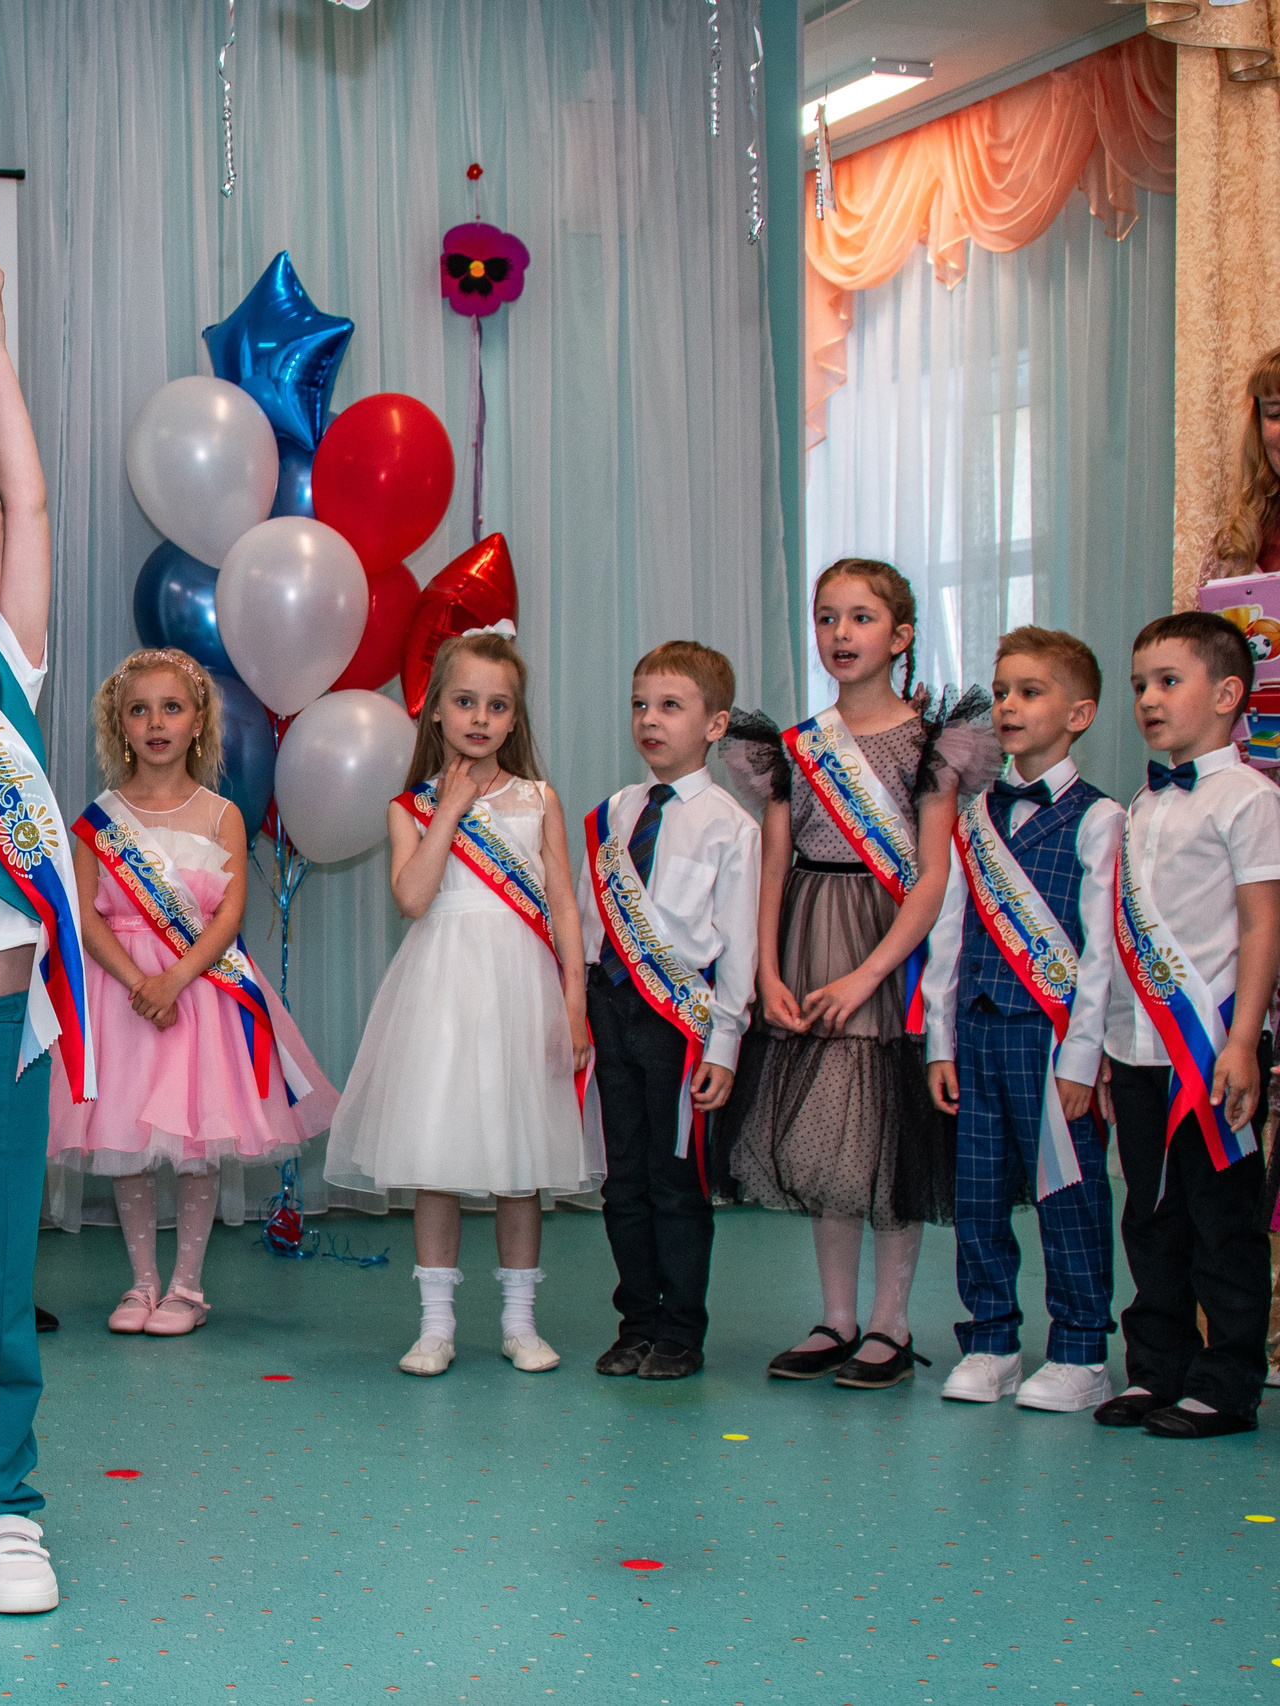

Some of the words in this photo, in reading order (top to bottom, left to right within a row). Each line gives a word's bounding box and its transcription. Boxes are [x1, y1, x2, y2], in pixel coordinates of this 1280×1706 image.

[812, 766, 867, 839] ДЕТСКОГО
[862, 837, 898, 879] САДА
[825, 752, 915, 874] Выпускник
[115, 861, 170, 929] ДЕТСКОГО
[166, 925, 190, 954] САД
[125, 850, 205, 940] Выпускни
[453, 829, 507, 883] ЕТСКОГО
[504, 882, 540, 919] САДА
[970, 827, 1055, 954] Выпускник
[601, 888, 642, 963] ДЕТСКОГО
[636, 962, 671, 1004] САДА
[611, 871, 696, 1000] Выпускник
[993, 912, 1028, 956] САДА
